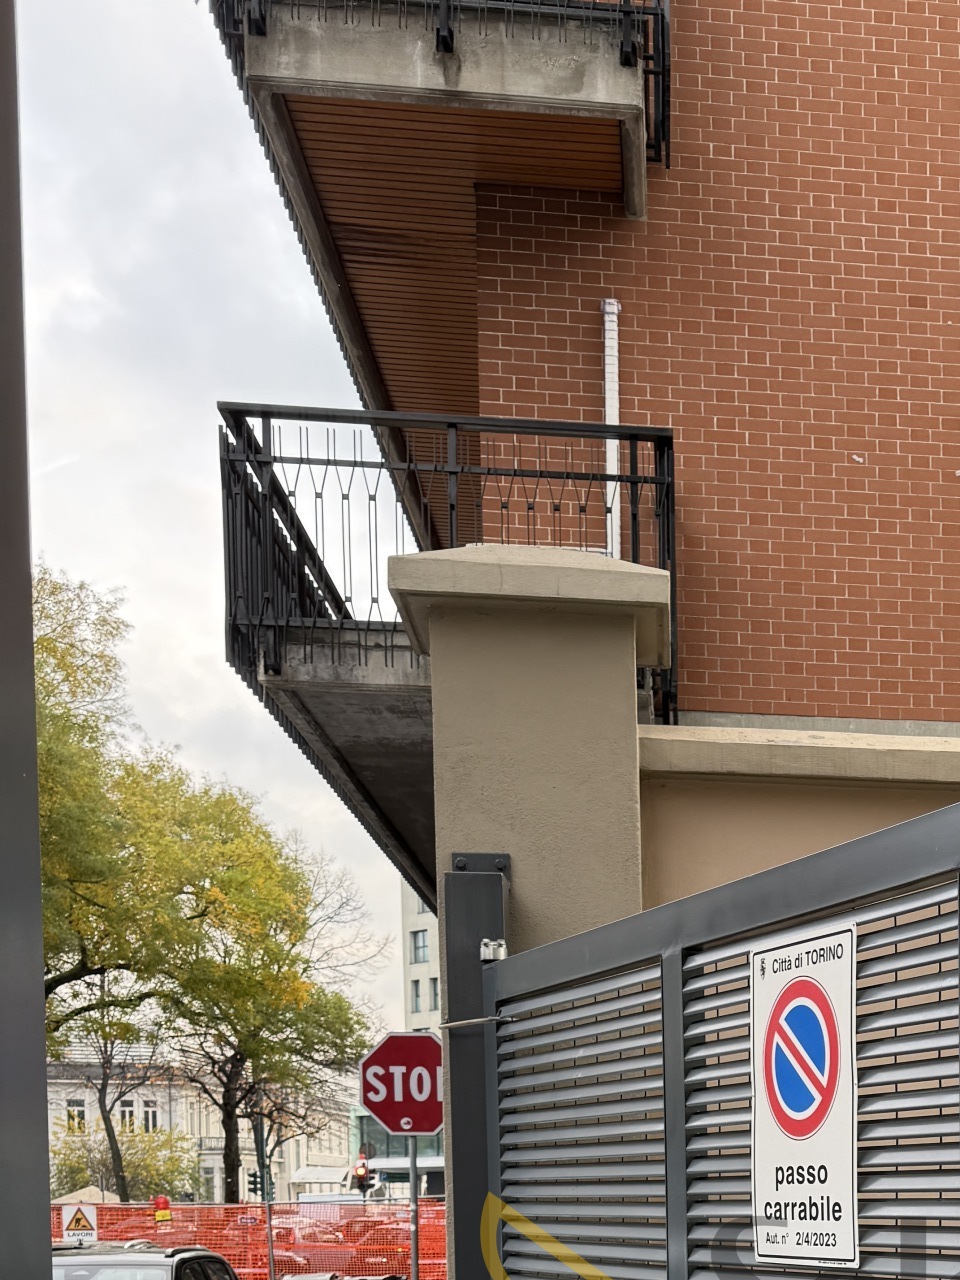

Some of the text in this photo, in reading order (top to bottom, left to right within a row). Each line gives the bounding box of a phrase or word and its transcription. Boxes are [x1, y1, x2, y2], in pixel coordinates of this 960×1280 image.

[772, 943, 844, 974] Città di TORINO
[775, 1164, 828, 1192] passo
[764, 1195, 842, 1222] carrabile
[765, 1231, 837, 1248] Aut. n° 2/4/2023
